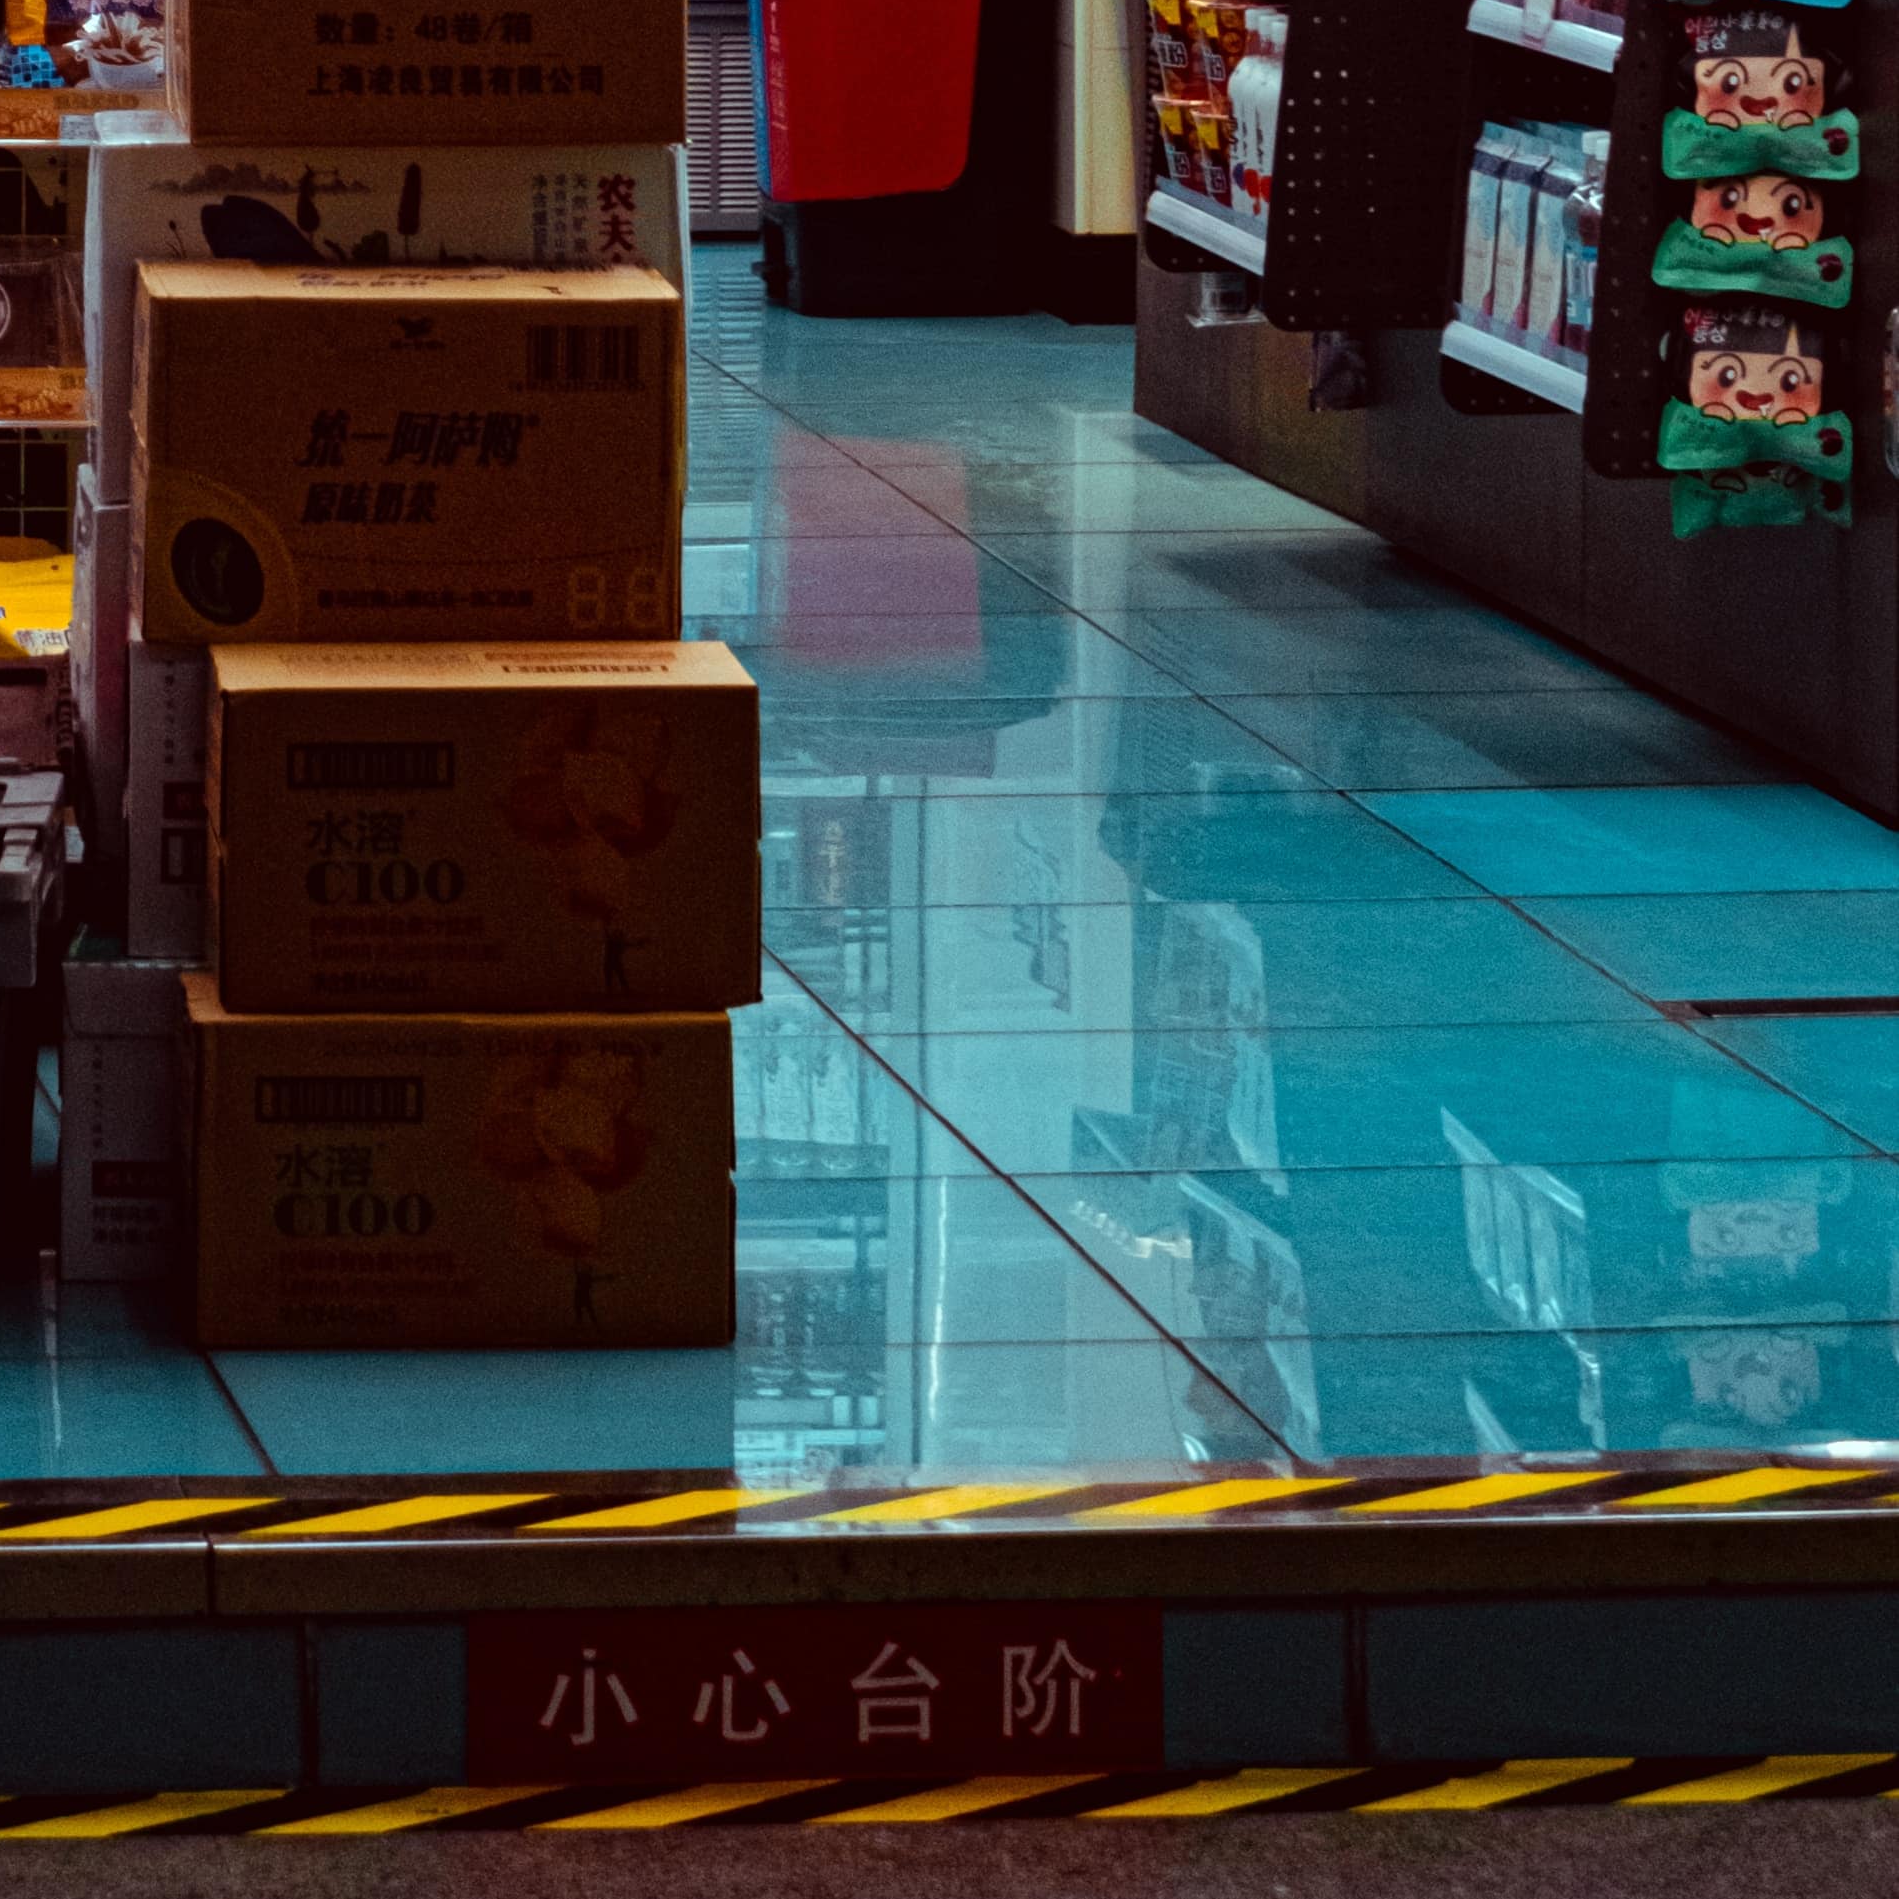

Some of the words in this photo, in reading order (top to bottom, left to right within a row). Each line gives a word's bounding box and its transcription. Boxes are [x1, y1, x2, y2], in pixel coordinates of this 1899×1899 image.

[598, 173, 639, 265] 农夫
[306, 809, 405, 856] 水溶
[303, 858, 467, 907] C100
[538, 1638, 1097, 1746] 小心台阶
